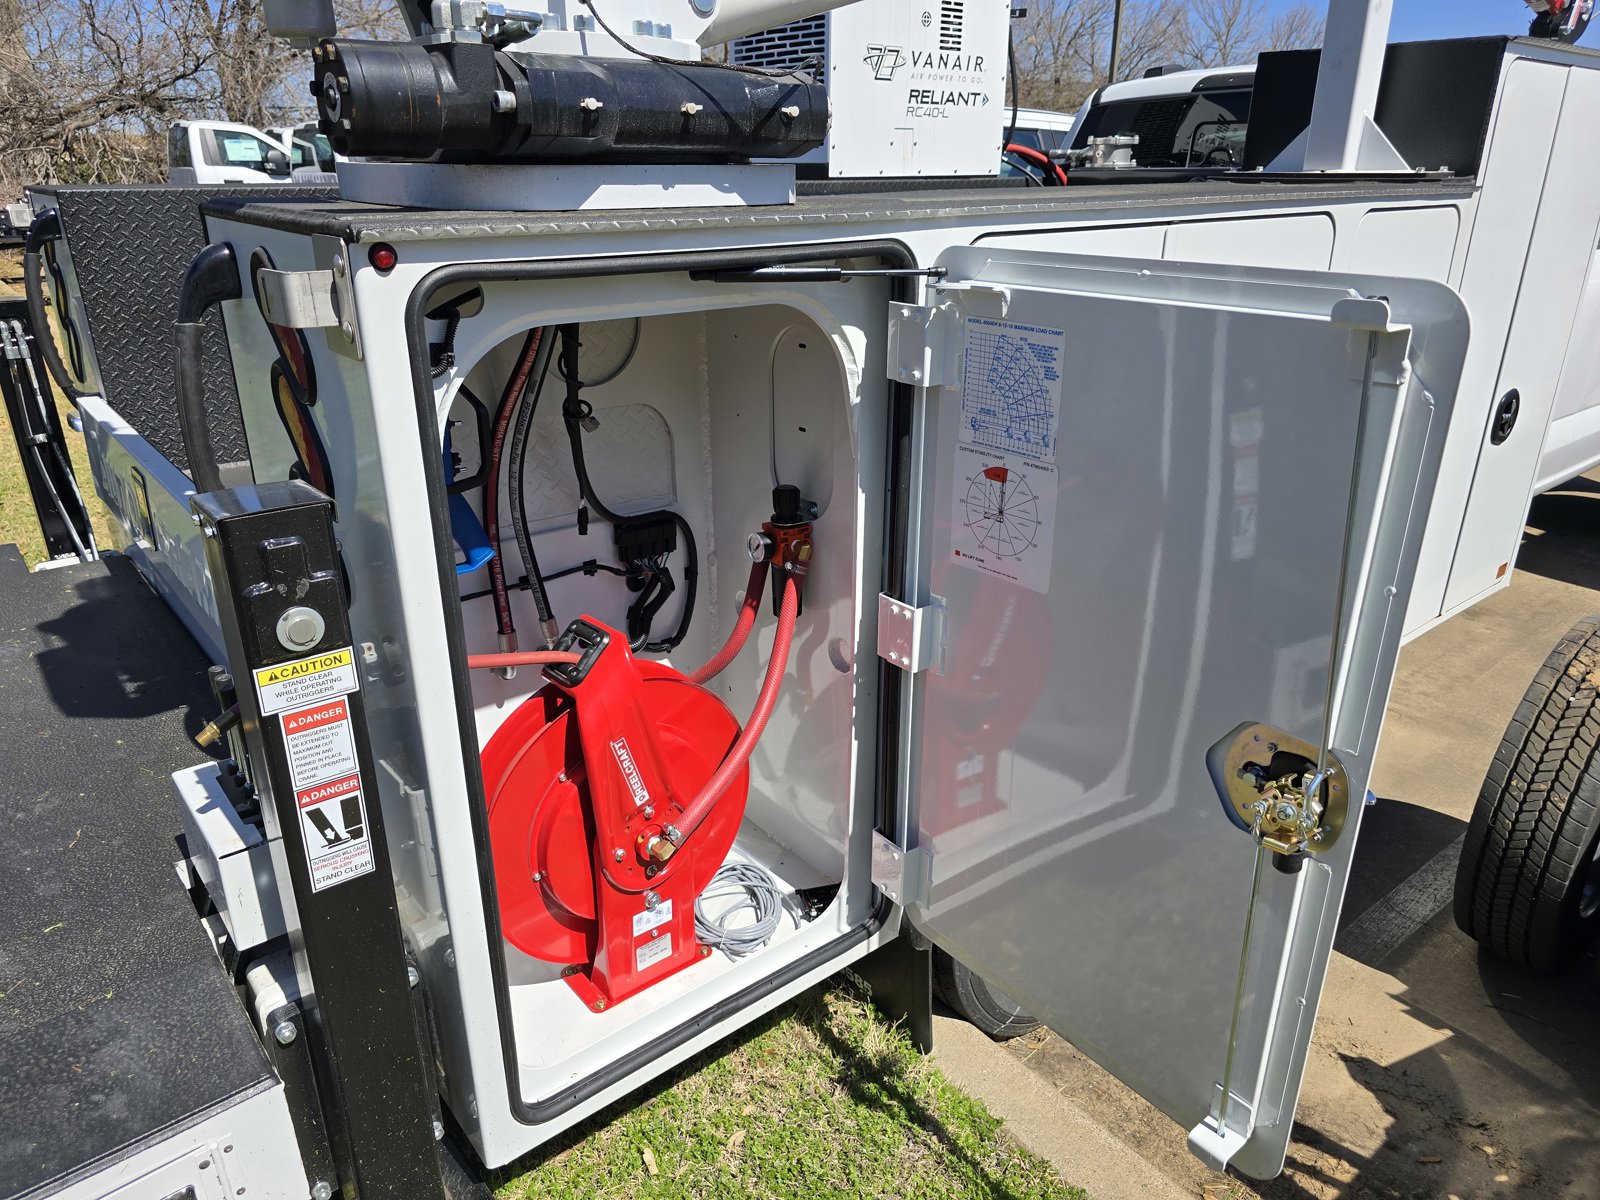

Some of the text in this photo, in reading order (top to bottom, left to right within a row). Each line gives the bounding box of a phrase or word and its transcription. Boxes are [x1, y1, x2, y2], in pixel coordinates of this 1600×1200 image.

[912, 50, 984, 72] VANAIR
[910, 72, 924, 80] AIR
[927, 73, 953, 82] POWER
[958, 75, 967, 83] TO
[908, 88, 981, 107] RELIANT
[905, 106, 949, 119] RC40-L
[1013, 323, 1034, 332] MAXIMUM
[959, 446, 1005, 461] CUSTOM STABILITY CHART
[280, 654, 343, 678] CAUTION
[275, 686, 300, 698] WHILE
[300, 676, 342, 691] OPERATING
[282, 671, 333, 689] STAND CLEAR
[286, 685, 335, 702] OUTRIGGERS
[298, 707, 343, 725] DANGER
[290, 723, 344, 742] OUTRIGGERS MUST
[300, 734, 330, 747] EXTENDED
[293, 744, 321, 755] MAXIMUM
[294, 751, 321, 762] POSITION
[295, 760, 317, 769] PINNED
[324, 752, 342, 760] PLACE
[296, 766, 319, 776] BEFORE
[320, 756, 352, 769] OPERATING
[614, 741, 645, 797] REELCRAFT
[310, 779, 358, 801] DANGER
[312, 844, 368, 866] OUTRIGGERS WILL CAUSE
[312, 860, 339, 872] SERIOUS
[339, 849, 370, 863] CRUSHING
[315, 871, 343, 885] STAND
[344, 860, 371, 876] CLEAR
[331, 860, 353, 871] INJURY
